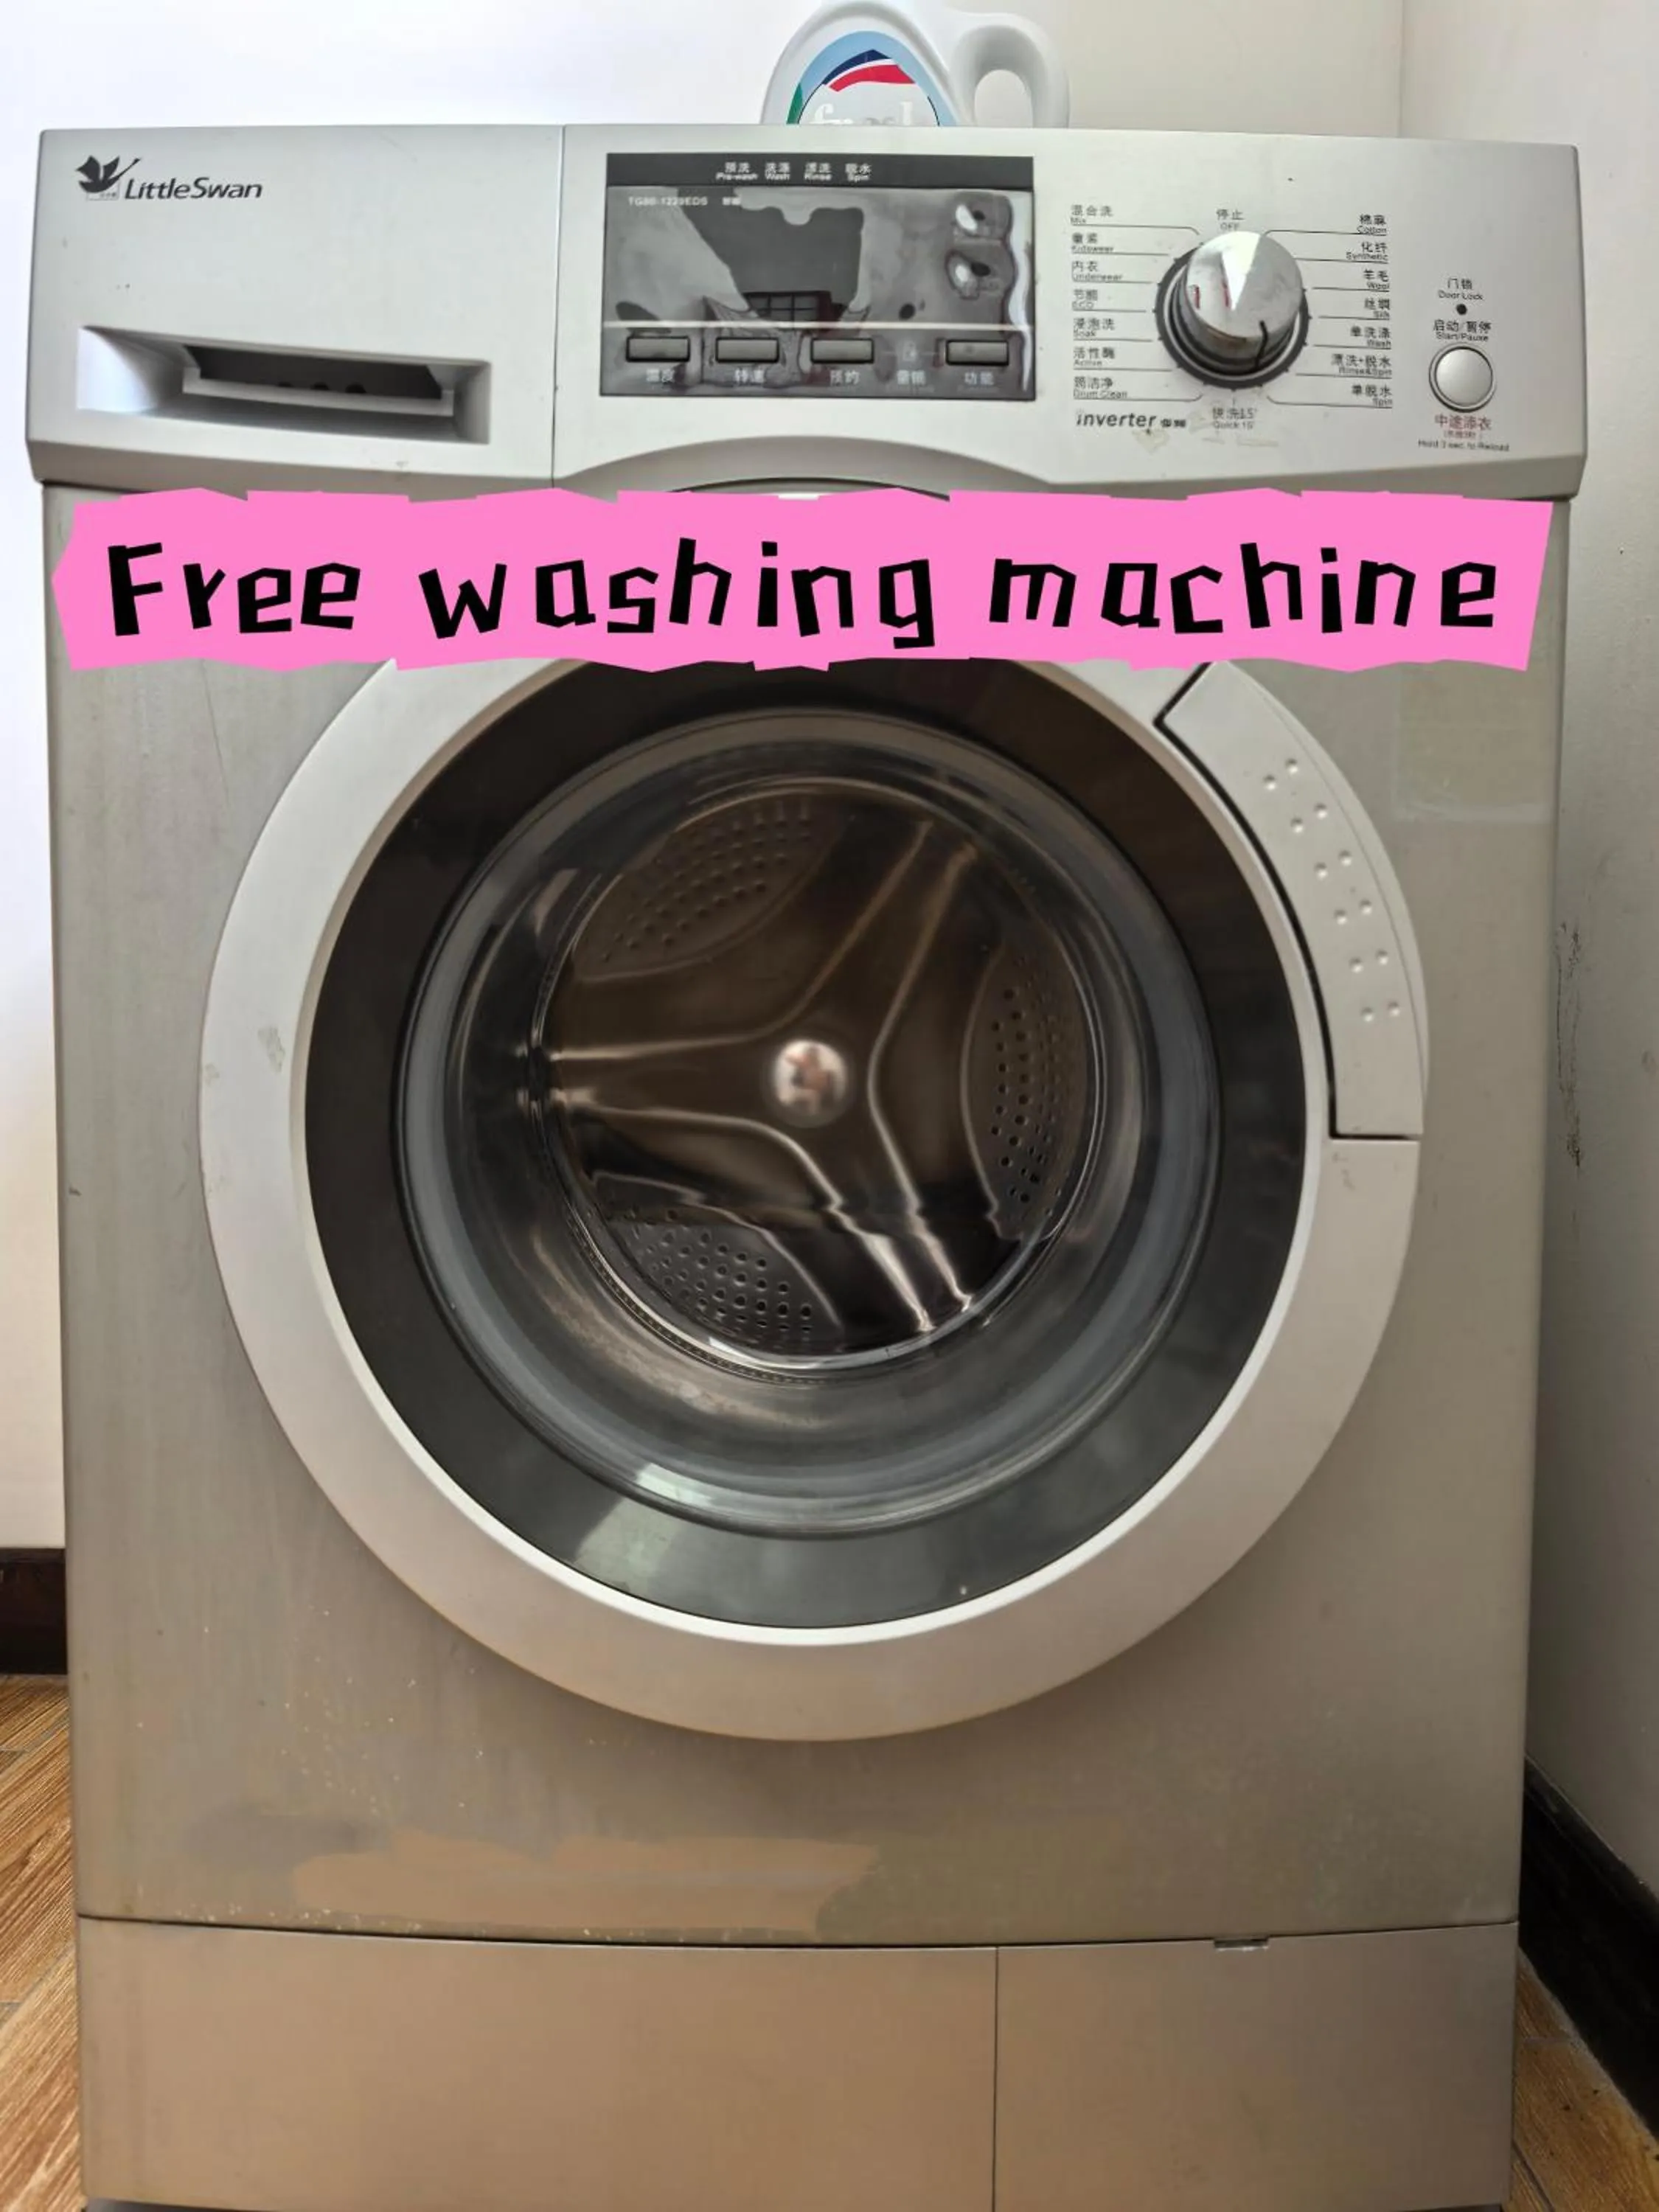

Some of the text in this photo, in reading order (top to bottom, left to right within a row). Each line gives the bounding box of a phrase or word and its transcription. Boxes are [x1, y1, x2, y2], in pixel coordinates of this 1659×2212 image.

[1071, 204, 1113, 217] 混合洗
[1216, 209, 1245, 220] 停止
[1361, 242, 1388, 254] 化纤
[1072, 261, 1098, 272] 内衣
[1363, 269, 1389, 282] 羊毛
[1438, 290, 1483, 300] Door Lock
[1074, 318, 1115, 330] 浸泡洗
[965, 372, 995, 386] 功能
[1076, 411, 1157, 427] inverter
